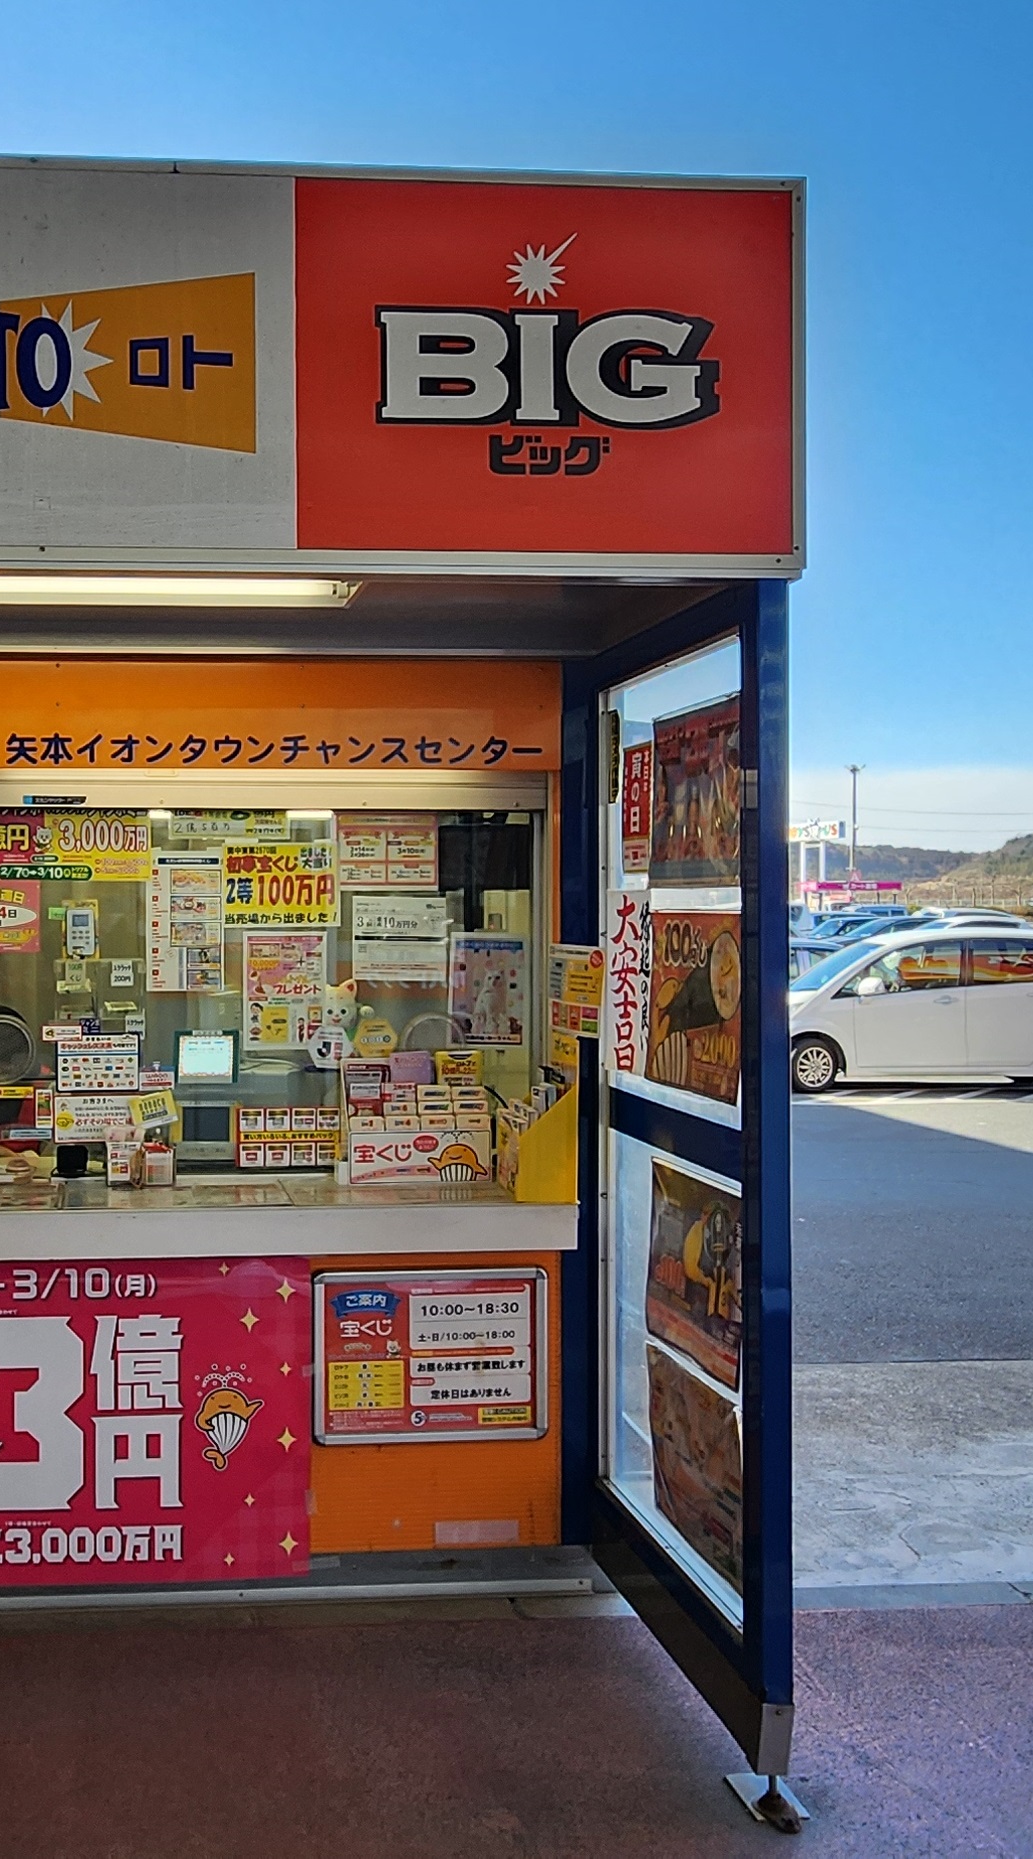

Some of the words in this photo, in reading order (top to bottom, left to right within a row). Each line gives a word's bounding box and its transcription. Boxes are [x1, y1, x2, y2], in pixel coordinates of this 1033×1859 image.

[129, 334, 233, 391] ロト
[375, 305, 720, 430] BIG
[488, 434, 611, 476] ビッグ
[5, 733, 544, 766] 矢本イオンタウンチャンスセンター
[58, 818, 148, 853] 3,000万円
[226, 877, 253, 904] 2等
[258, 874, 335, 906] 100万円
[224, 912, 337, 925] 当売場から出ました！
[273, 984, 322, 995] プレゼント
[610, 895, 640, 1073] 大安吉日
[354, 1145, 411, 1163] 宝くじ
[346, 1294, 387, 1307] ご案内
[340, 1320, 392, 1338] 宝くじ
[417, 1360, 525, 1372] お昼も休まず営業致します
[430, 1388, 511, 1400] 定休日はありません
